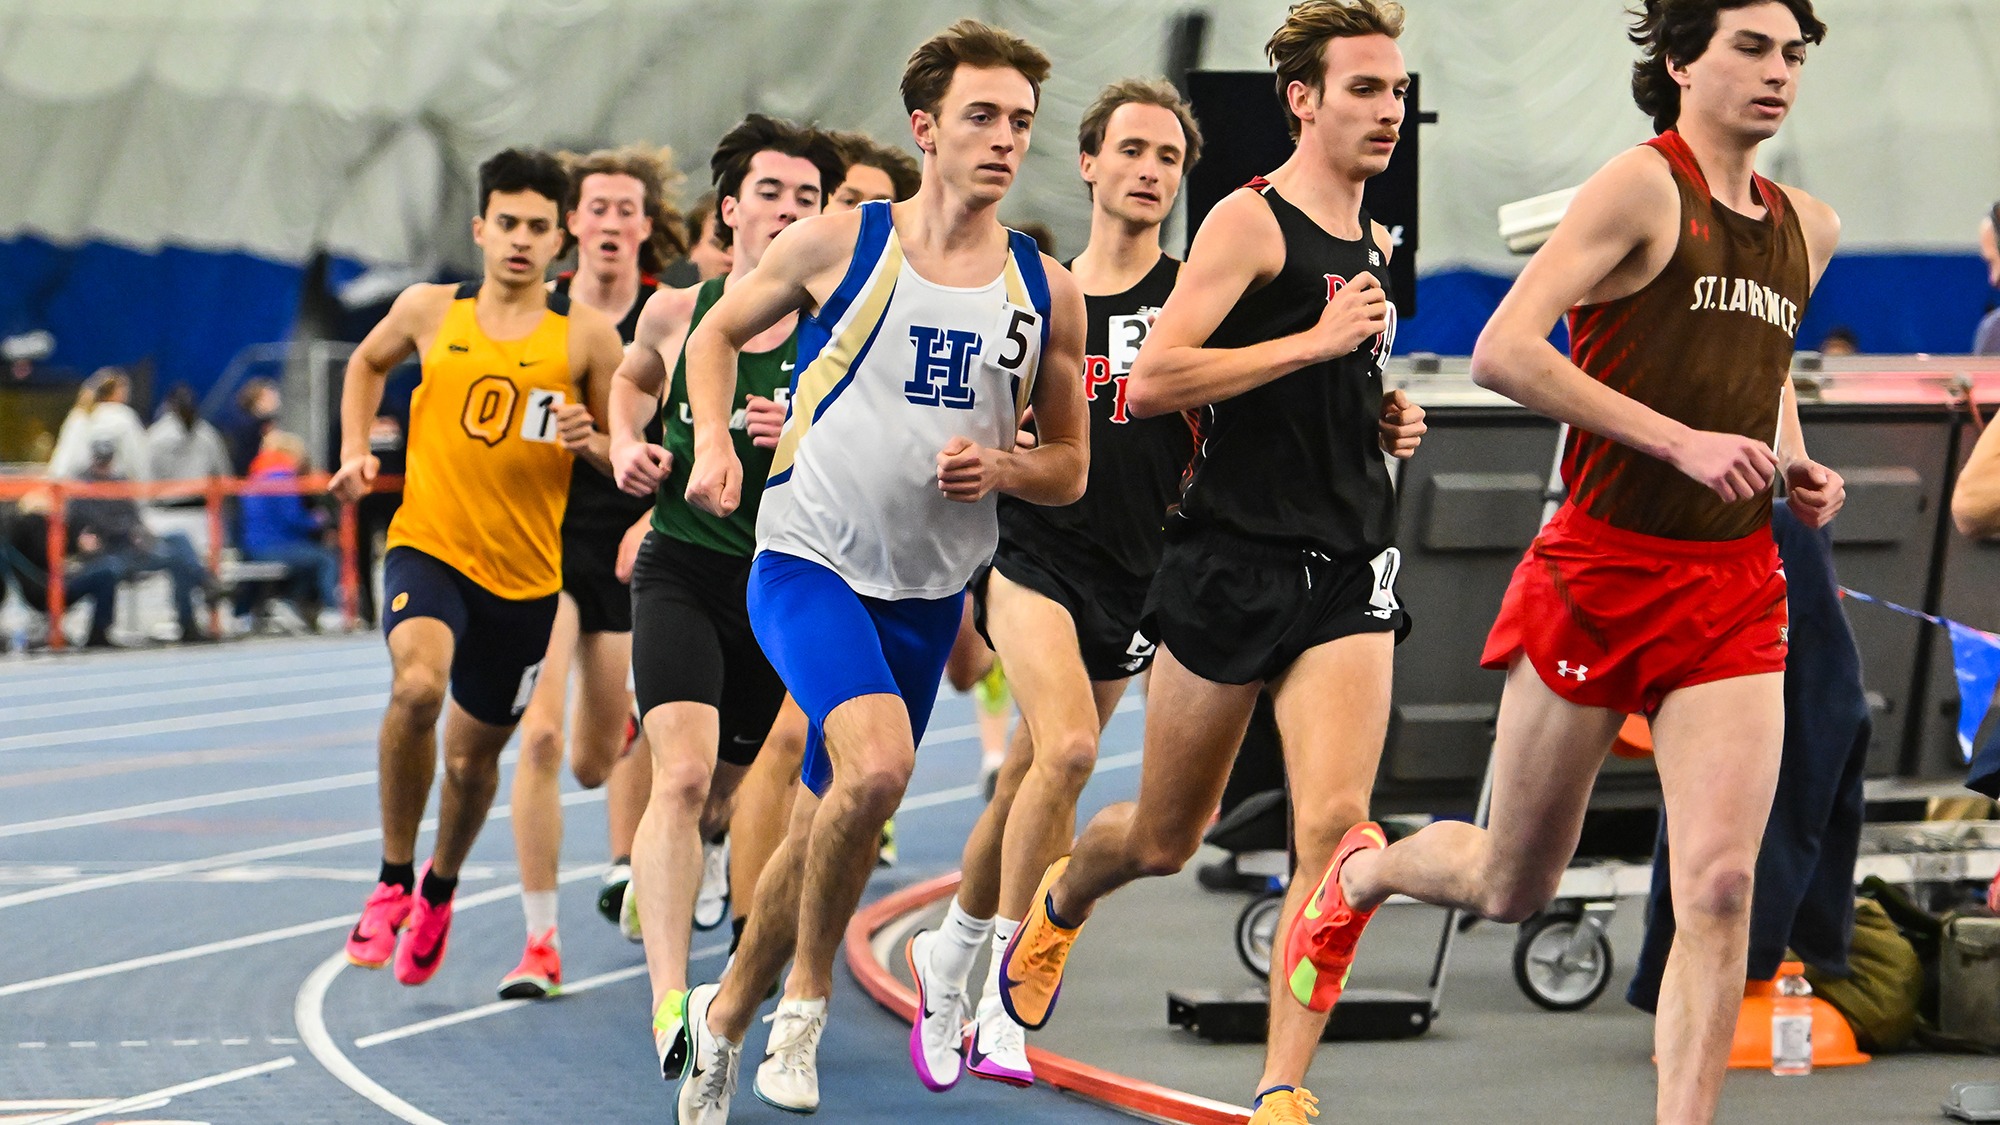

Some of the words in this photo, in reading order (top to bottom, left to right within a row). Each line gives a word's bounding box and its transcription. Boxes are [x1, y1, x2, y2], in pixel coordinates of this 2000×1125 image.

[904, 324, 983, 410] H
[997, 309, 1036, 370] 5
[1121, 319, 1148, 370] 3
[460, 374, 519, 448] Q
[538, 395, 554, 438] 1
